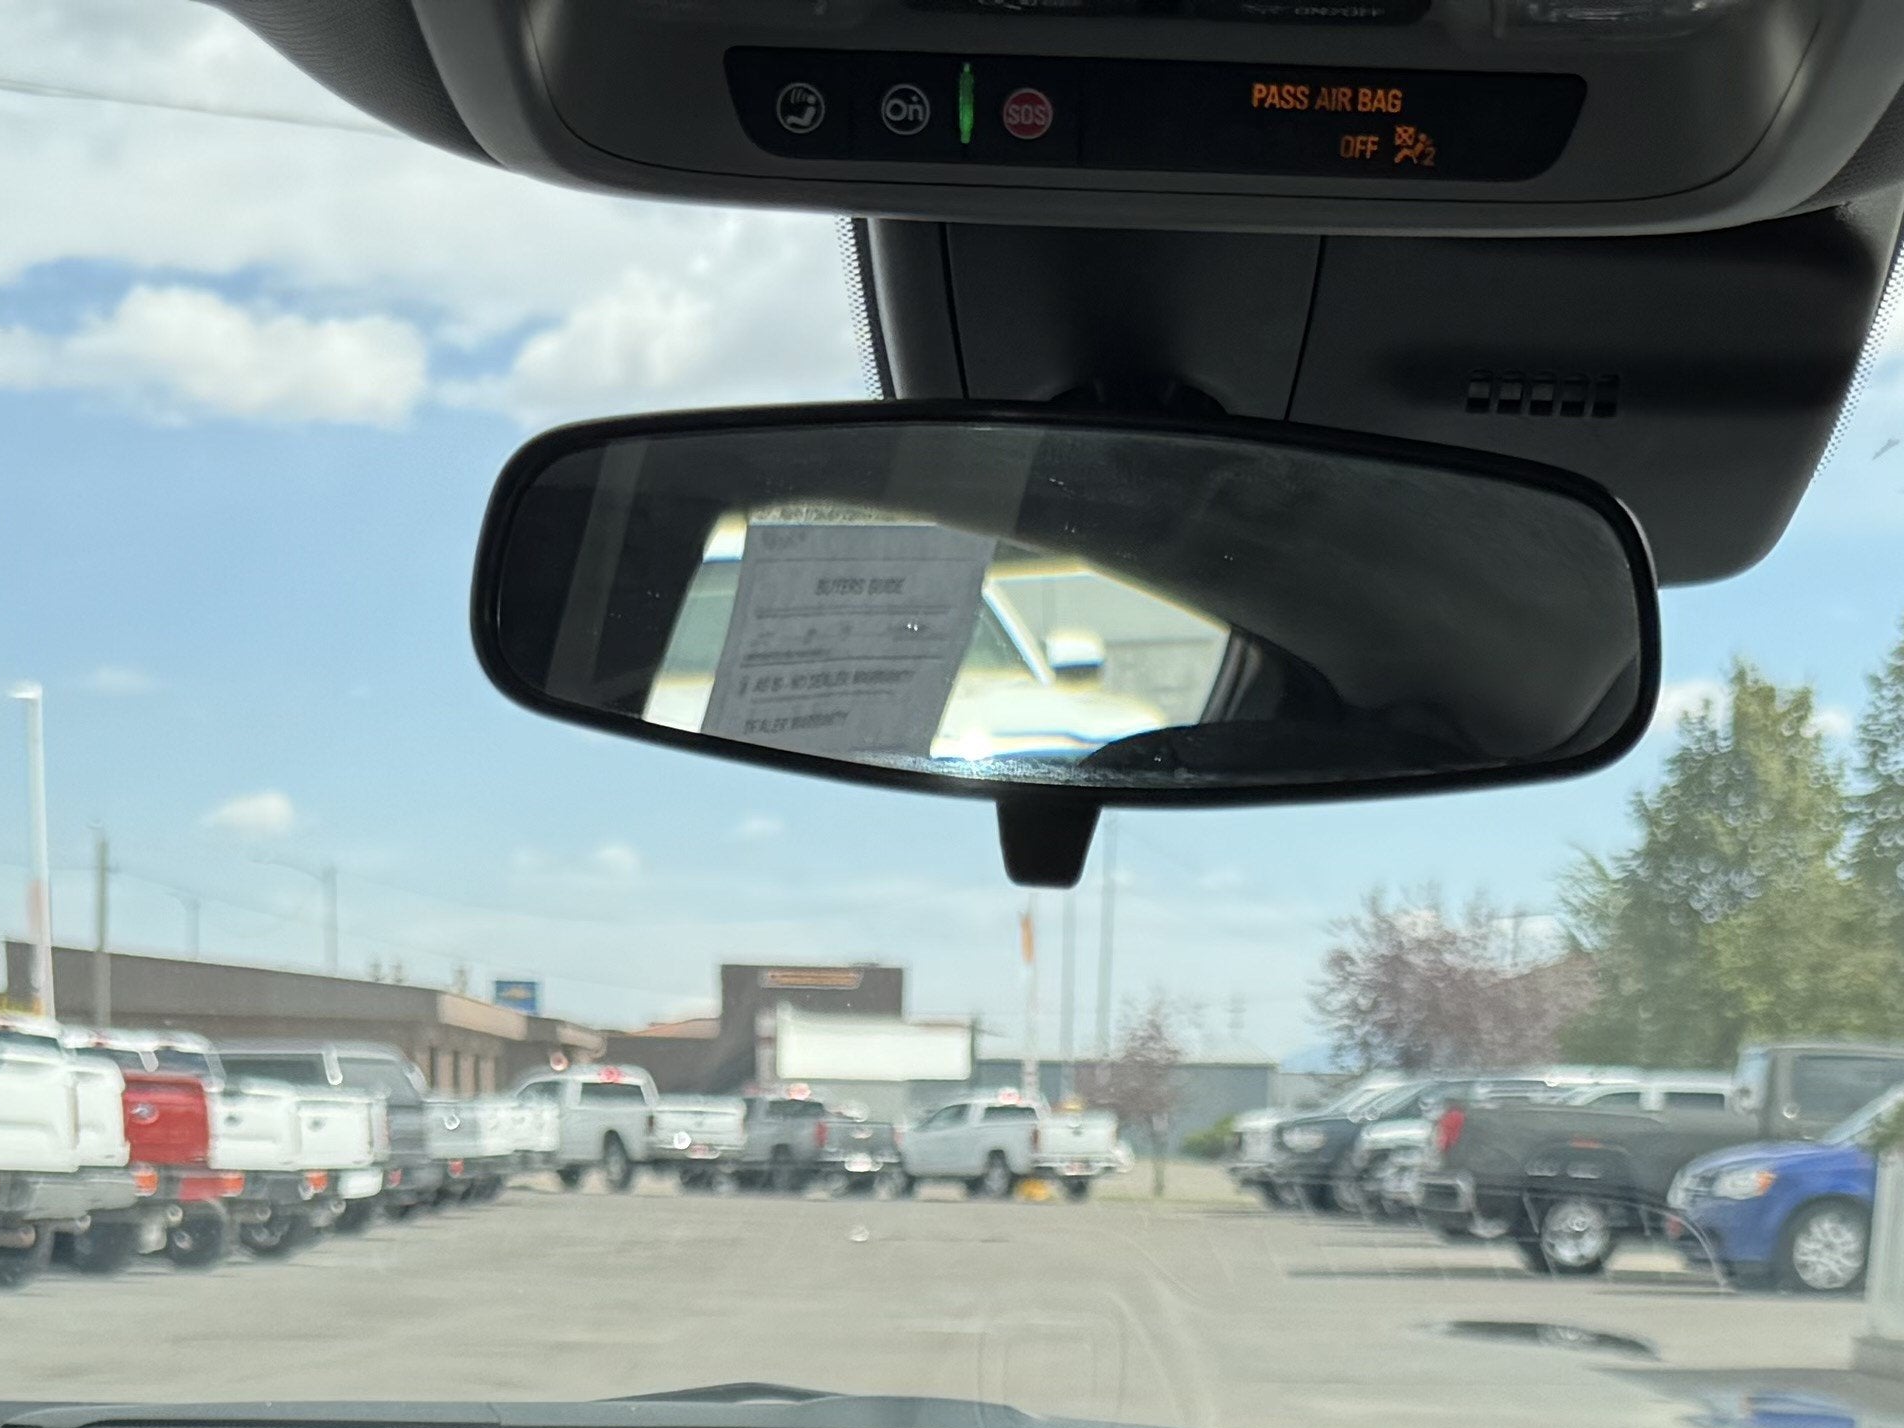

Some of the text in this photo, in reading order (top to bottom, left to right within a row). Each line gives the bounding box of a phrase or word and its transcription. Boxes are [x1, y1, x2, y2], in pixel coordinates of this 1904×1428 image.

[1251, 82, 1402, 114] PASS AIR BAG
[1007, 102, 1048, 125] SOS
[1339, 135, 1379, 159] OFF
